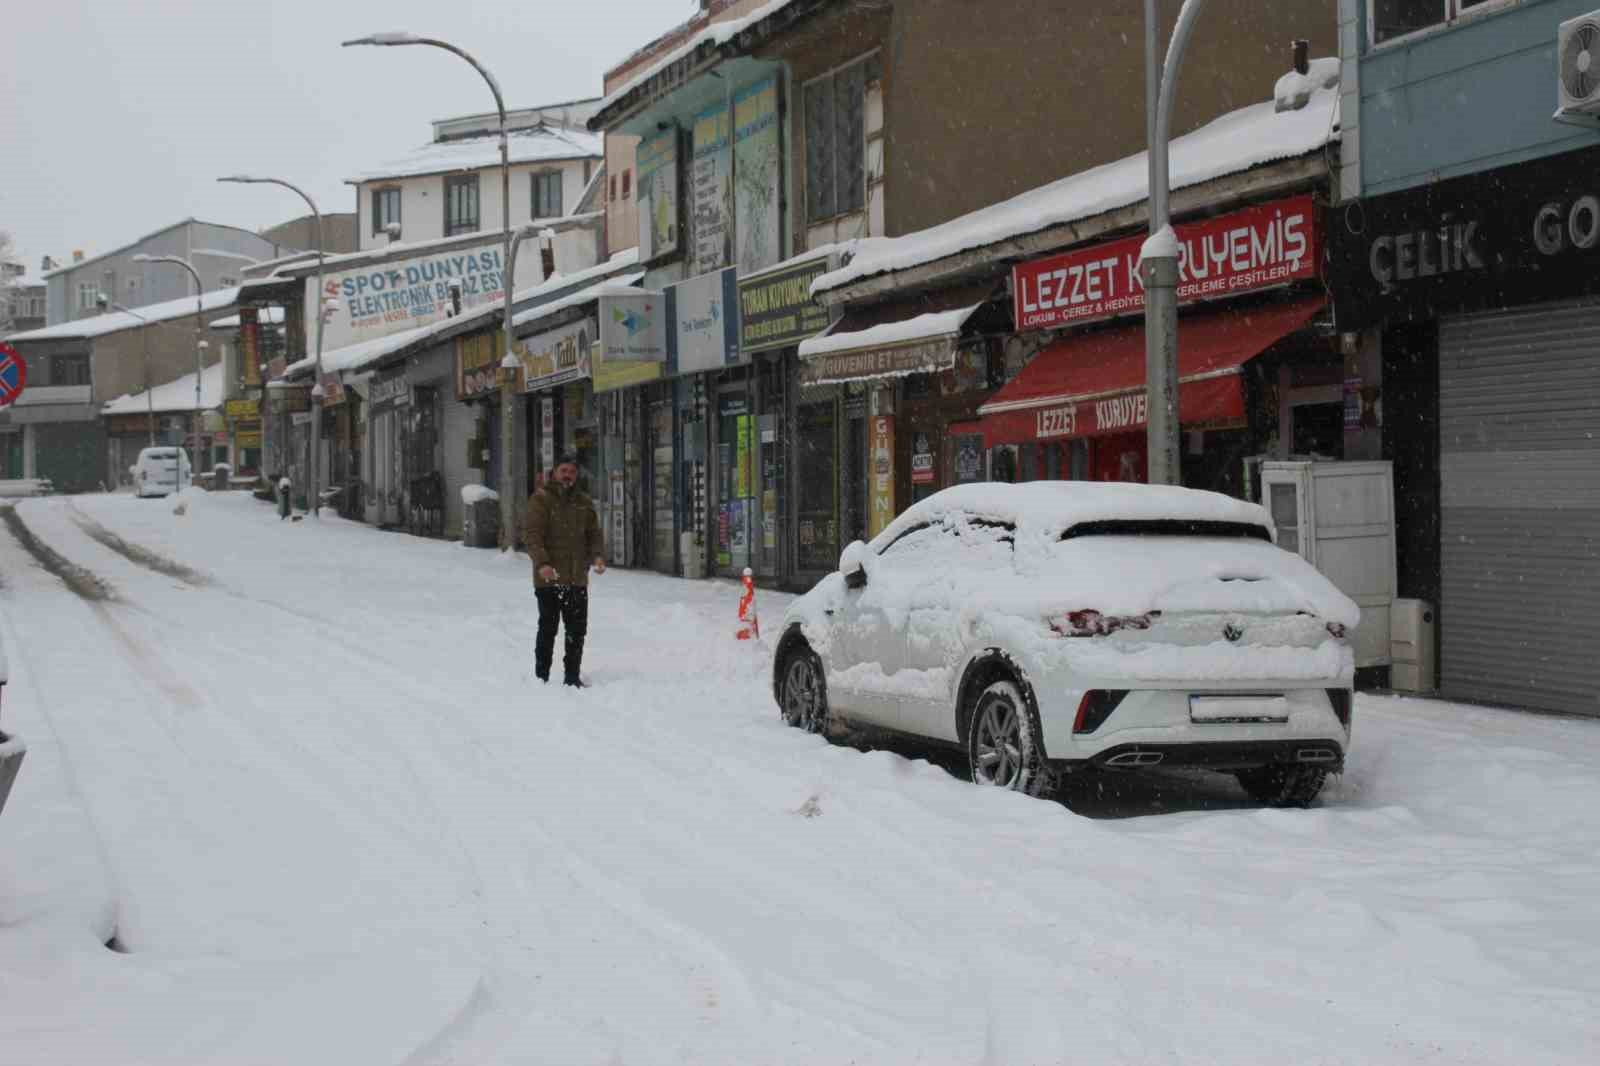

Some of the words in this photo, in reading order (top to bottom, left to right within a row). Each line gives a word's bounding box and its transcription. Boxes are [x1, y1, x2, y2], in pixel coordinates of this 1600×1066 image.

[1021, 256, 1119, 313] LEZZET
[1127, 210, 1307, 294] KRUYEMİŞ
[1369, 211, 1484, 295] ÇELİK
[342, 270, 398, 297] SPOT
[348, 286, 433, 319] ELEKTRONİK
[436, 275, 479, 300] BEAZ
[1023, 312, 1056, 327] LOKUM
[1062, 303, 1093, 321] ÇEREZ
[1103, 294, 1146, 311] HEDİYEL
[1228, 262, 1290, 295] ÇEŞİTLERİ
[1036, 405, 1077, 438] LEZZET
[1095, 394, 1148, 430] KURUYE
